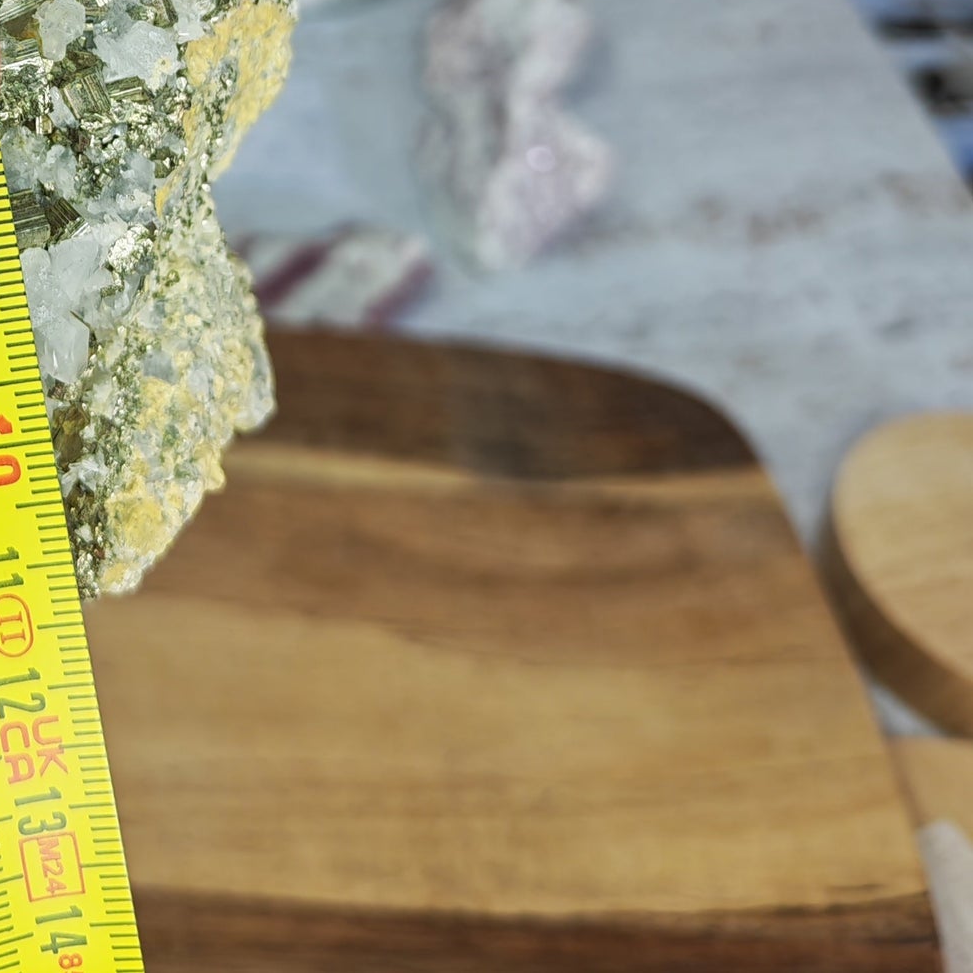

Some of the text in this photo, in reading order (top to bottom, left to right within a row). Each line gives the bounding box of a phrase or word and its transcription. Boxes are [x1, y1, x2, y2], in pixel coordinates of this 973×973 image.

[0, 721, 35, 784] CA
[31, 715, 69, 777] UK
[14, 786, 67, 836] 13
[37, 835, 68, 897] M24
[34, 905, 88, 955] 14
